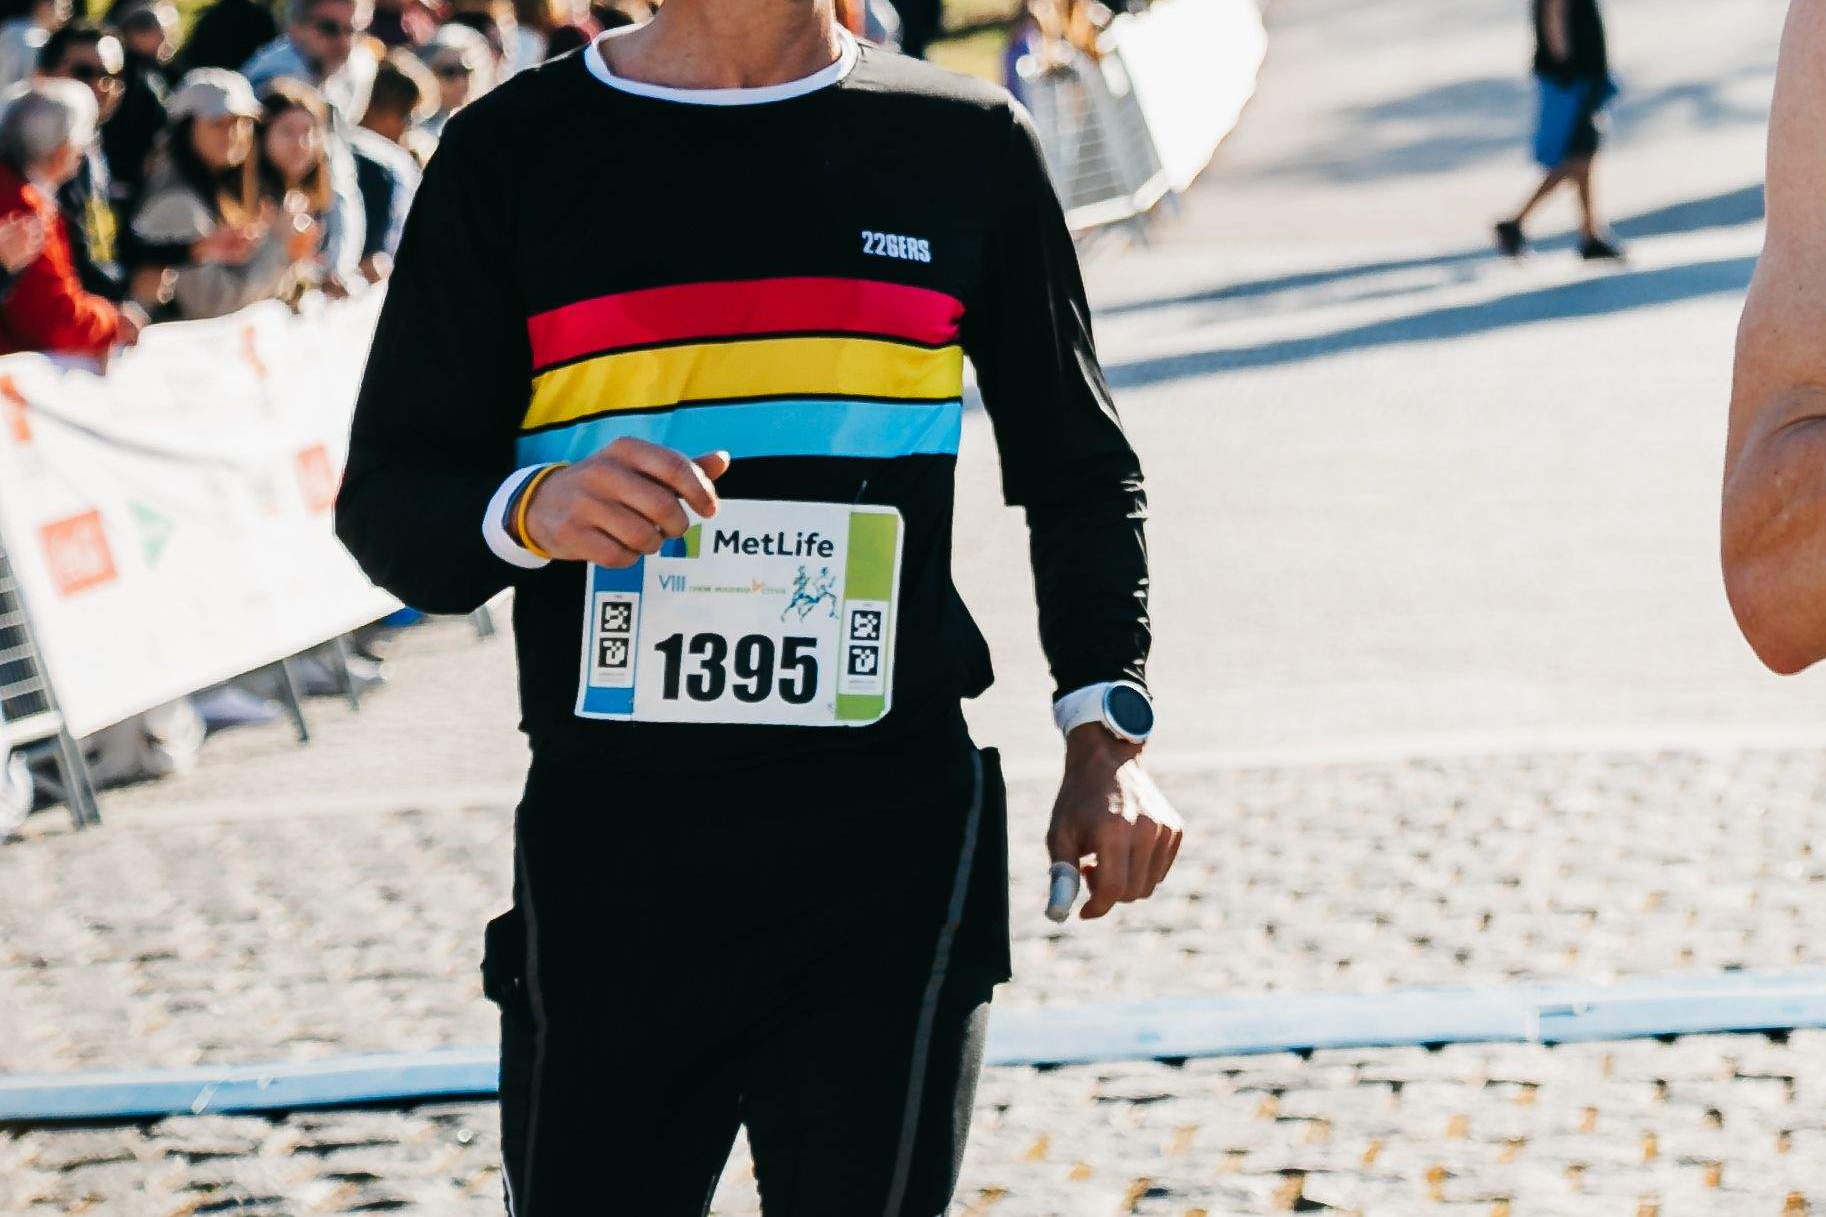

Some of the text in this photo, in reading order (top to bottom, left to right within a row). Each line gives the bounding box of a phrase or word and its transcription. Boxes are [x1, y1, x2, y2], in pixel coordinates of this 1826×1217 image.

[861, 230, 931, 263] 226ERS
[713, 529, 835, 558] MetLife
[659, 574, 686, 592] VIII
[655, 632, 818, 705] 1395
